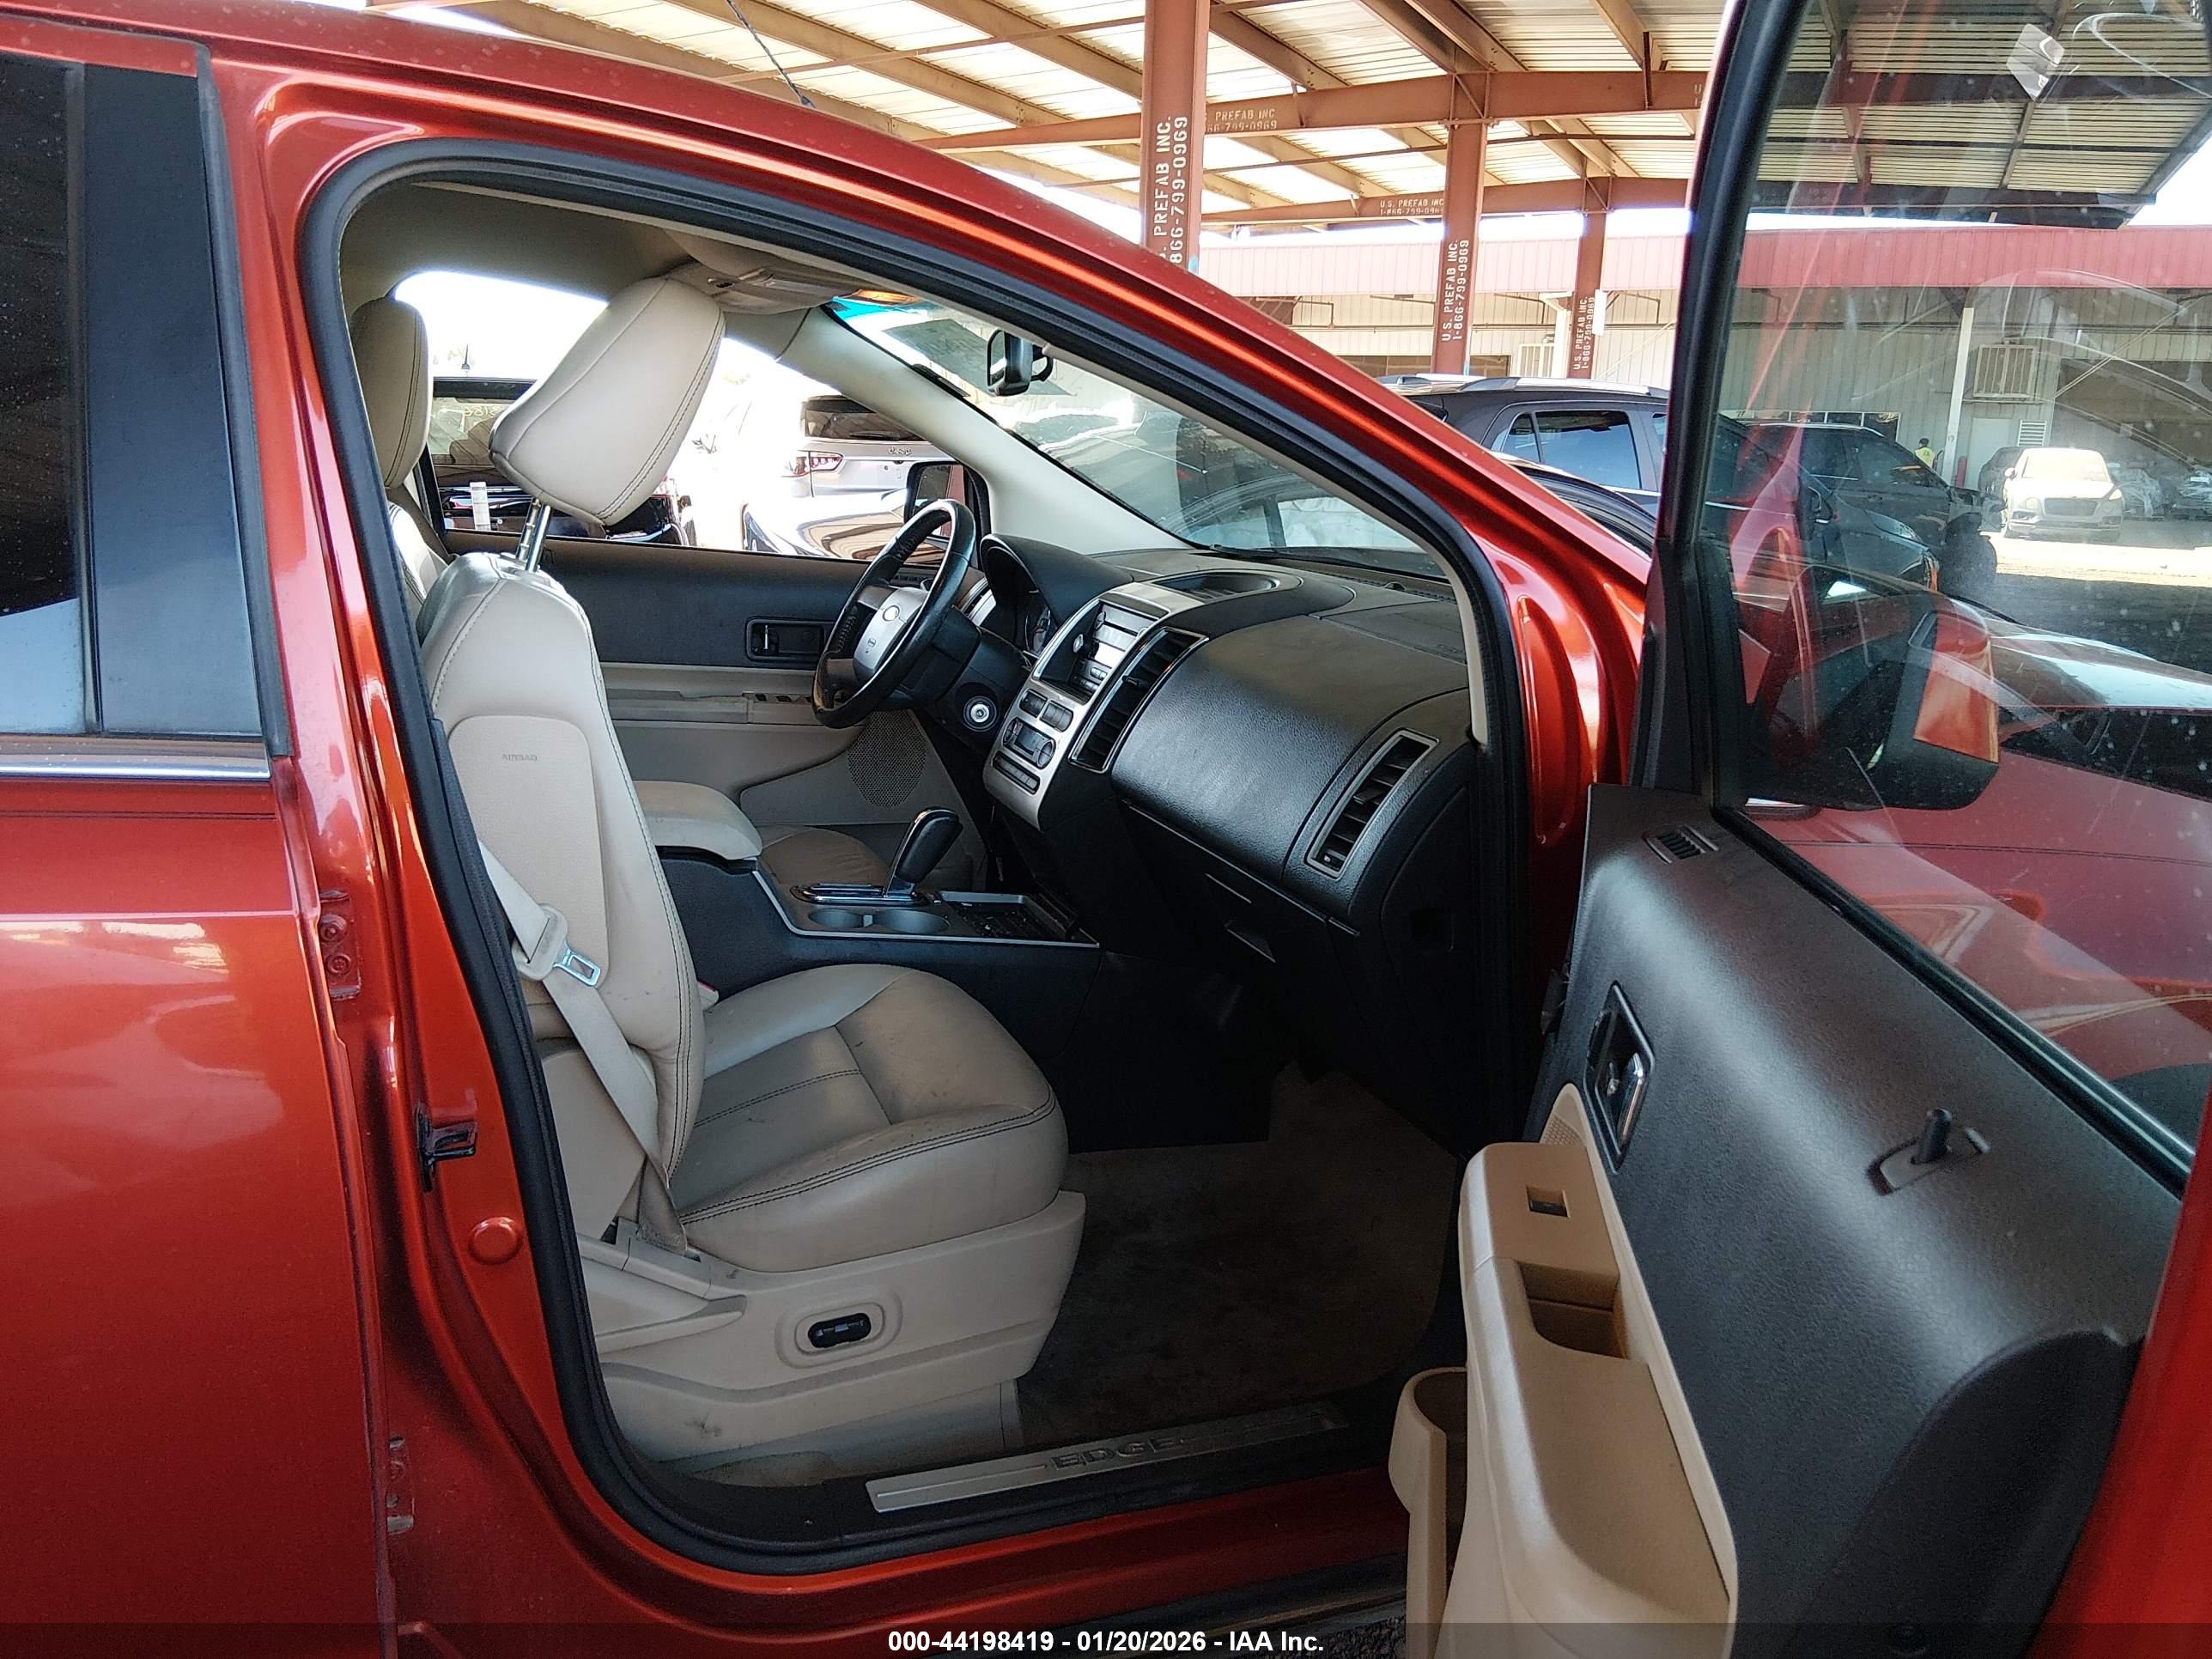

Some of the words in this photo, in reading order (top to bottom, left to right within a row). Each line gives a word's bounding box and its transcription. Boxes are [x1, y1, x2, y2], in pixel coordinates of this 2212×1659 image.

[1215, 109, 1254, 121] PREFAB
[1156, 116, 1171, 153] INC.
[1154, 162, 1170, 236] PREFAB
[1380, 199, 1395, 208] U.S.
[1398, 198, 1428, 208] PREFAB
[1447, 240, 1458, 262] INC.
[1443, 267, 1456, 313] PREFAB
[1452, 240, 1470, 340] 1-866-799-0969
[1578, 296, 1589, 313] INC.
[1441, 319, 1453, 342] U.S.
[1575, 316, 1586, 349] PREFAB
[1572, 353, 1582, 370] U.S.
[1051, 1437, 1180, 1470] EDGE
